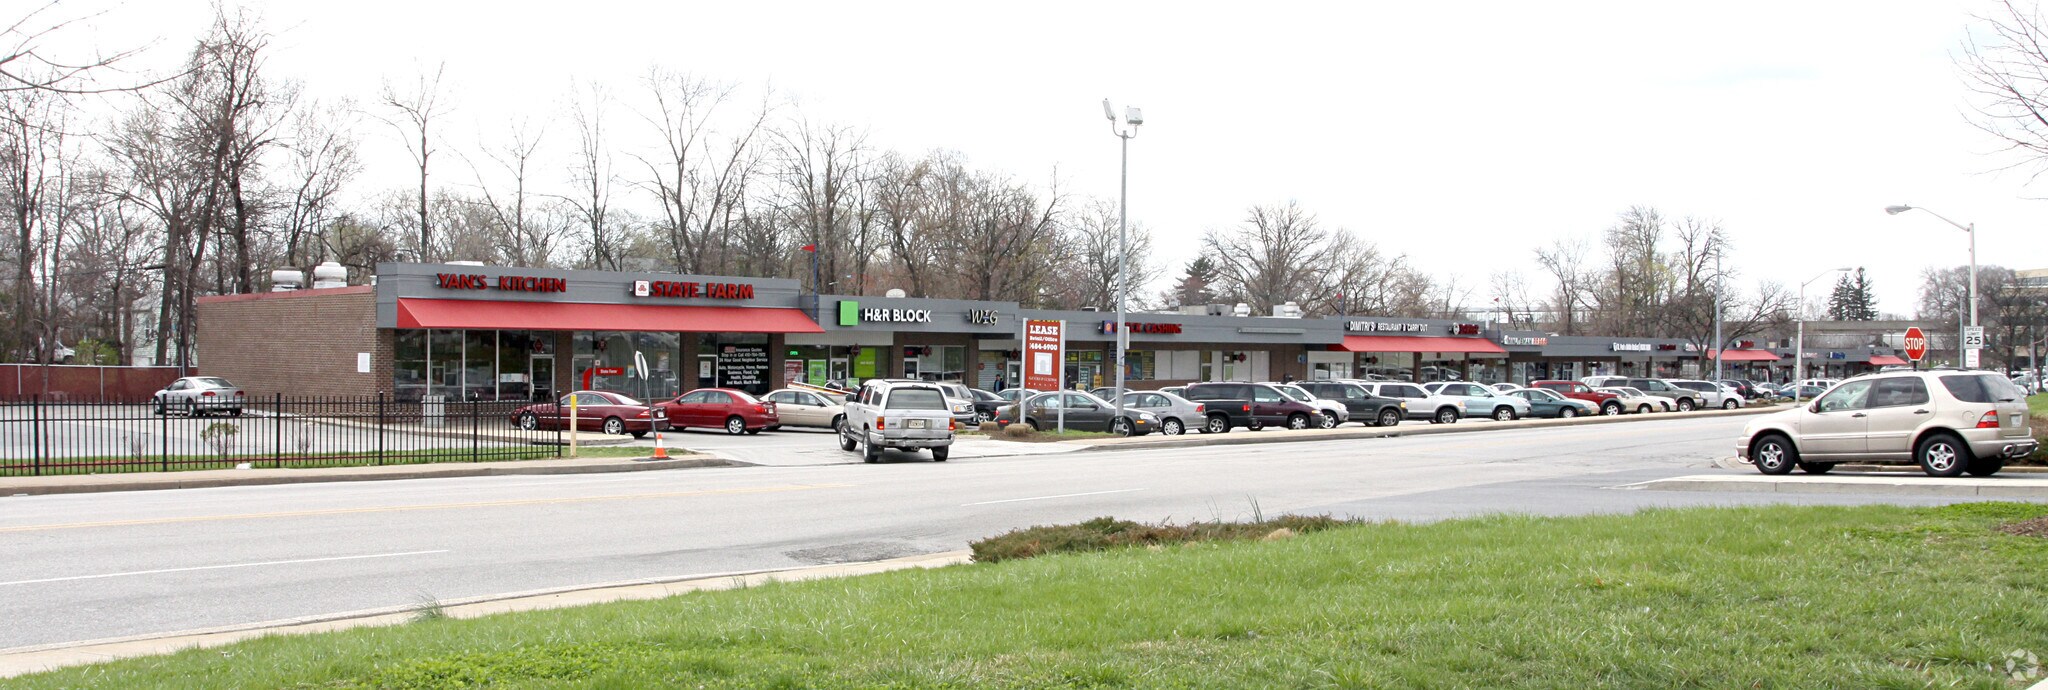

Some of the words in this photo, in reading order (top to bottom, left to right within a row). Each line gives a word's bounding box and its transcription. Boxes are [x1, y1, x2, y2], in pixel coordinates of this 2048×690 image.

[437, 273, 488, 290] YAN'S
[499, 276, 566, 292] KITCHEN
[652, 281, 700, 298] STATE
[707, 283, 754, 299] FARM
[864, 308, 890, 322] H&R
[893, 309, 931, 322] BLOCK
[971, 309, 998, 326] WIG
[1030, 325, 1058, 336] LEASE
[1144, 324, 1182, 334] CASHING
[1350, 321, 1375, 332] DIMITRI'S
[1906, 338, 1924, 350] STOP
[1966, 336, 1981, 344] 25
